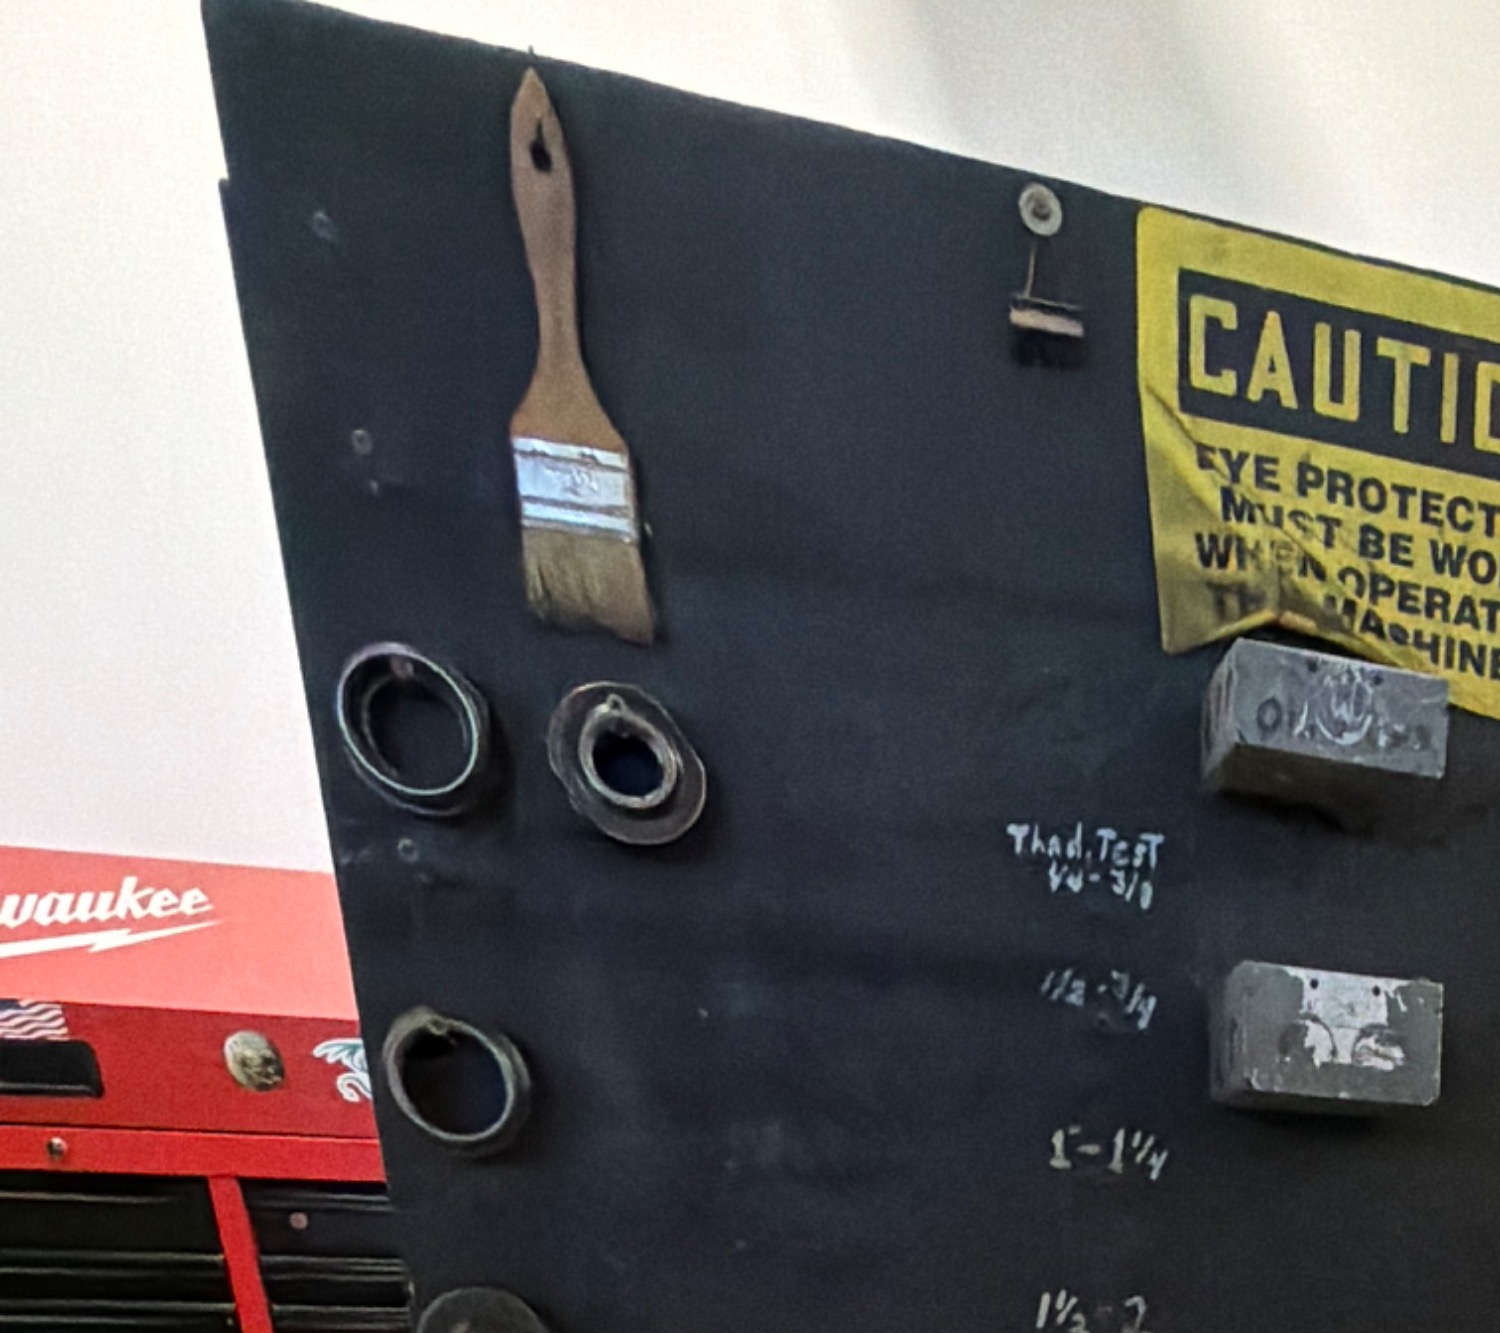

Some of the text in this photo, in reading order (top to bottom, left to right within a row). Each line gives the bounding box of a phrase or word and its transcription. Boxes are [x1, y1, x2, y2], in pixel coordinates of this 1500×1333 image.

[1194, 443, 1281, 493] EYE
[1219, 486, 1343, 549] MUST
[1358, 523, 1414, 568] BE
